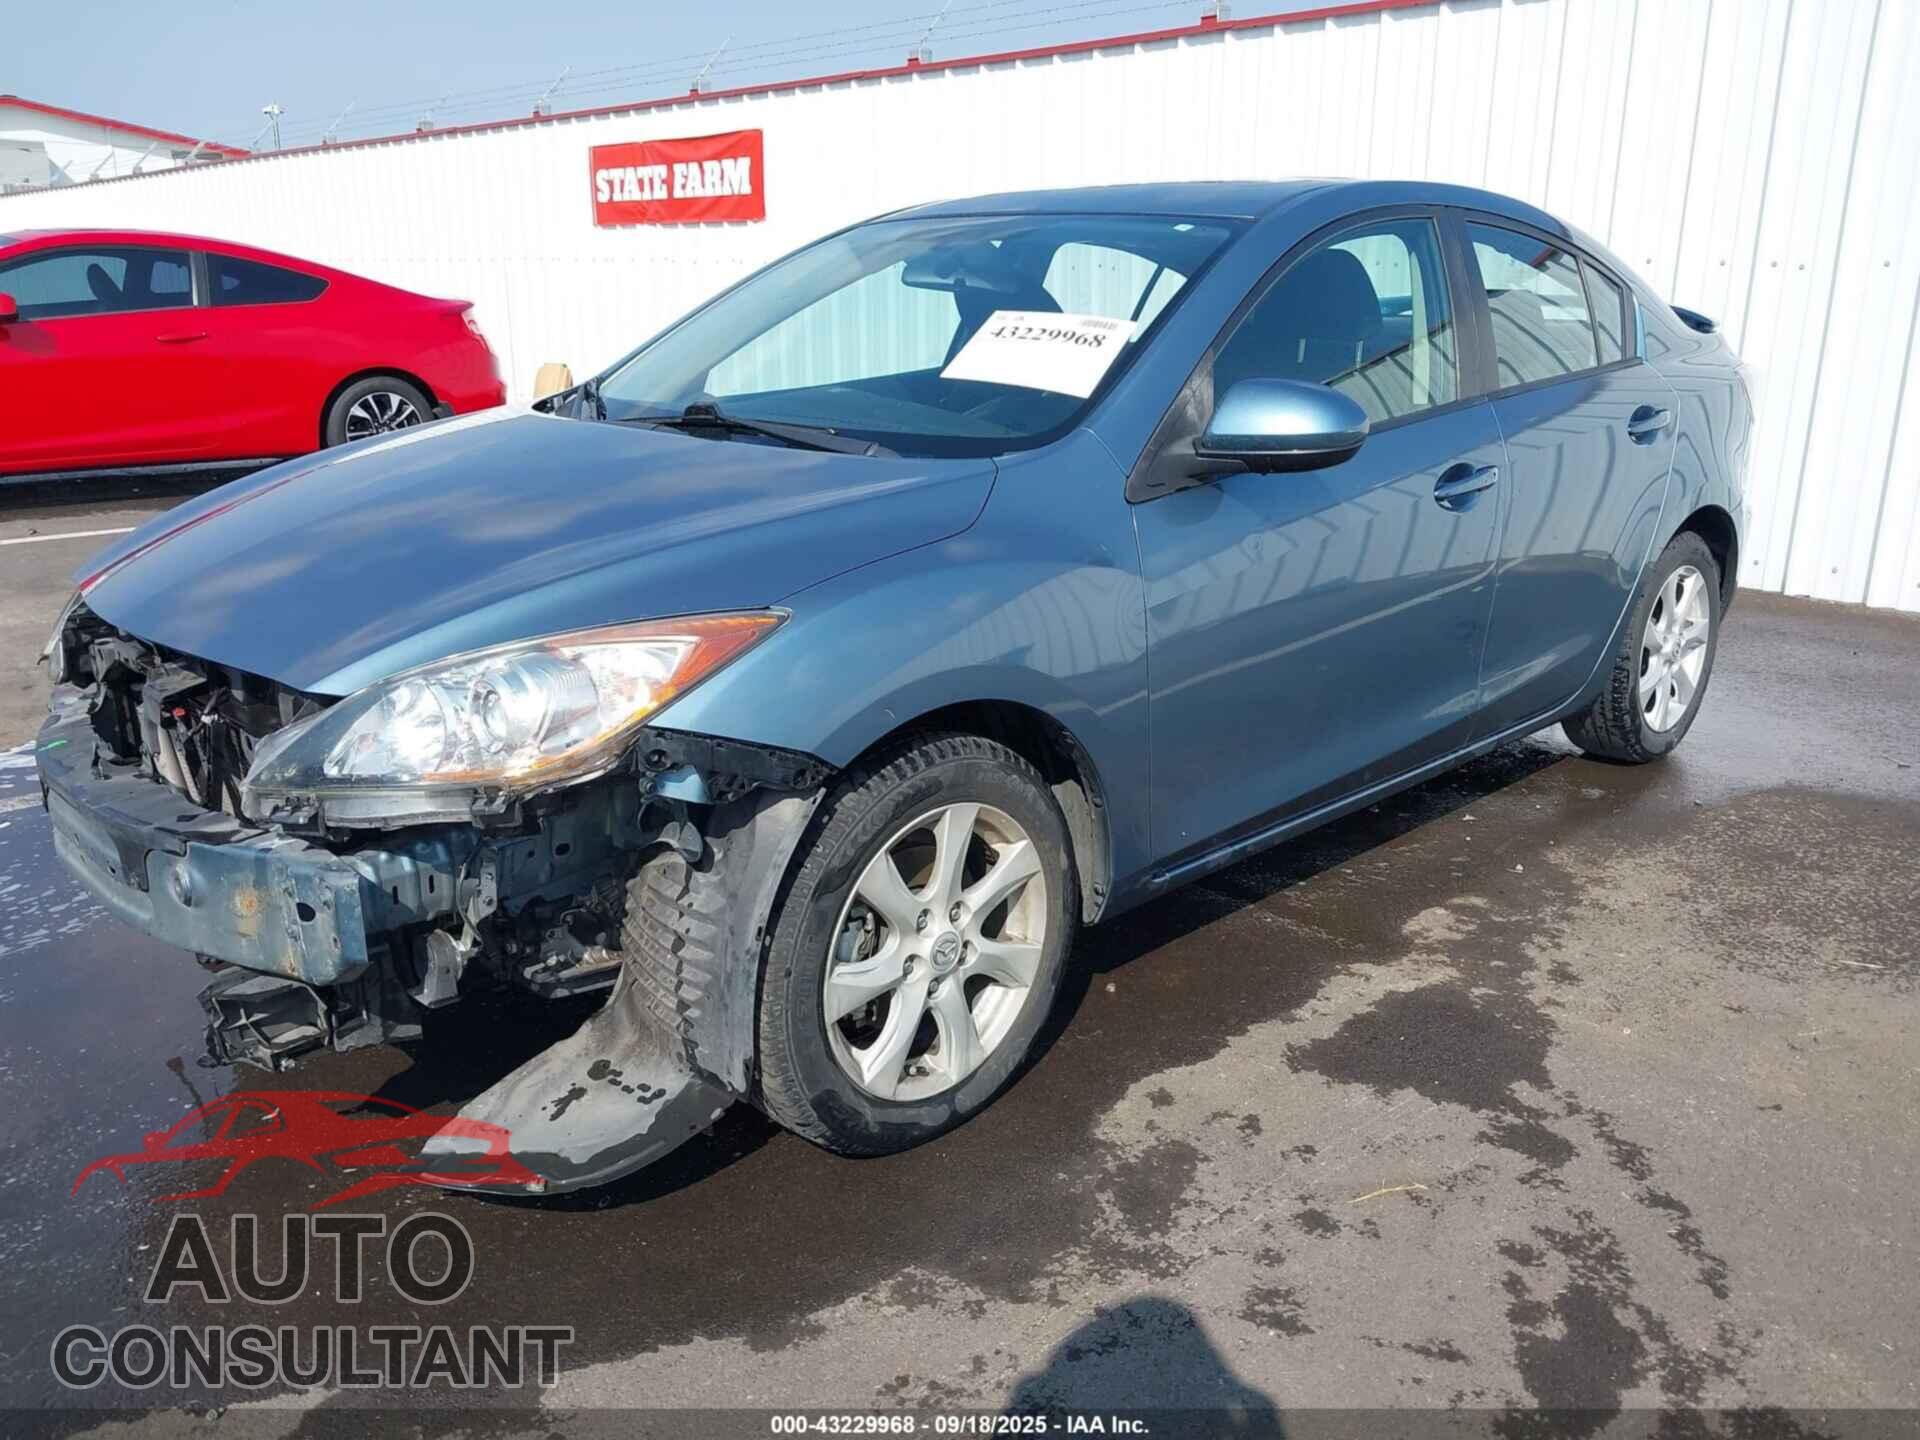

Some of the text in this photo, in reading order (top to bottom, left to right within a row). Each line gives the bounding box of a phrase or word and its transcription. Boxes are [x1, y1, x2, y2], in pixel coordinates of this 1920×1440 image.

[595, 156, 753, 204] STATE FARM
[990, 325, 1107, 349] 43229968
